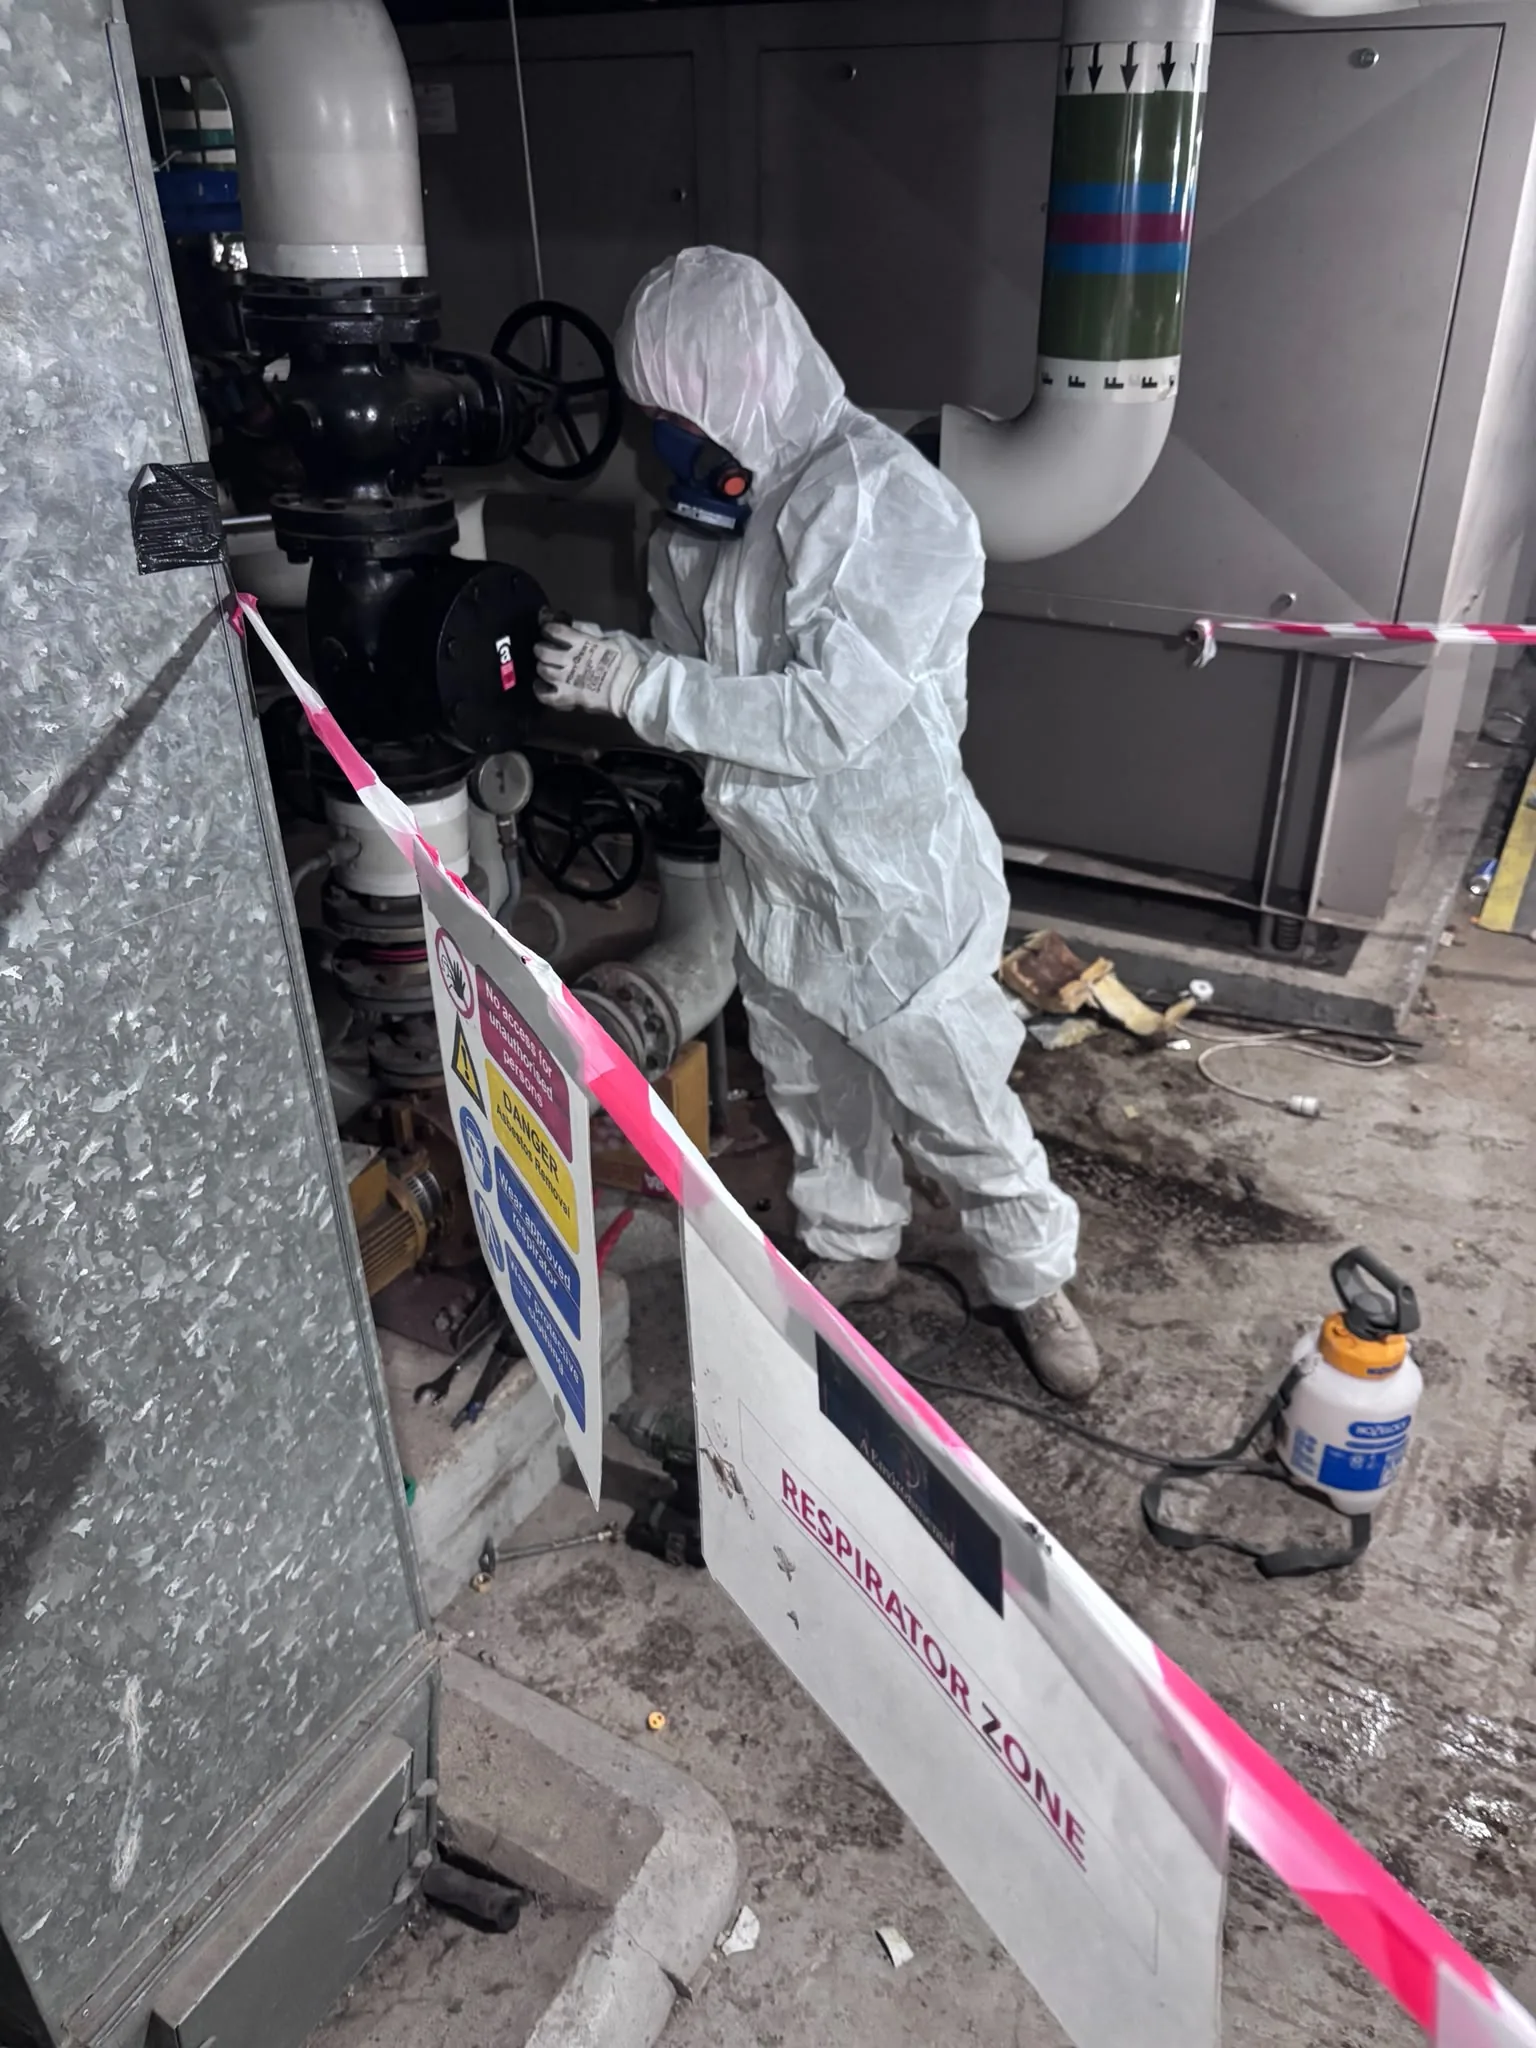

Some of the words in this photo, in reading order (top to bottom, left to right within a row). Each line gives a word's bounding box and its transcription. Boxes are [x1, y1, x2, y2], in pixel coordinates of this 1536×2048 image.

[485, 981, 501, 1010] No
[502, 1005, 537, 1057] access
[538, 1050, 553, 1079] for
[489, 1010, 554, 1102] unauthorised
[503, 1049, 543, 1108] persons
[496, 1104, 533, 1163] Asbestos
[535, 1157, 571, 1219] Removal
[503, 1089, 560, 1184] DANGER
[499, 1167, 523, 1213] Wear
[525, 1212, 572, 1292] approved
[512, 1212, 559, 1290] respirator
[528, 1306, 564, 1376] clothing
[534, 1299, 580, 1385] protective
[781, 1468, 971, 1715] RESPIRATOR
[981, 1702, 1086, 1862] ZONE
